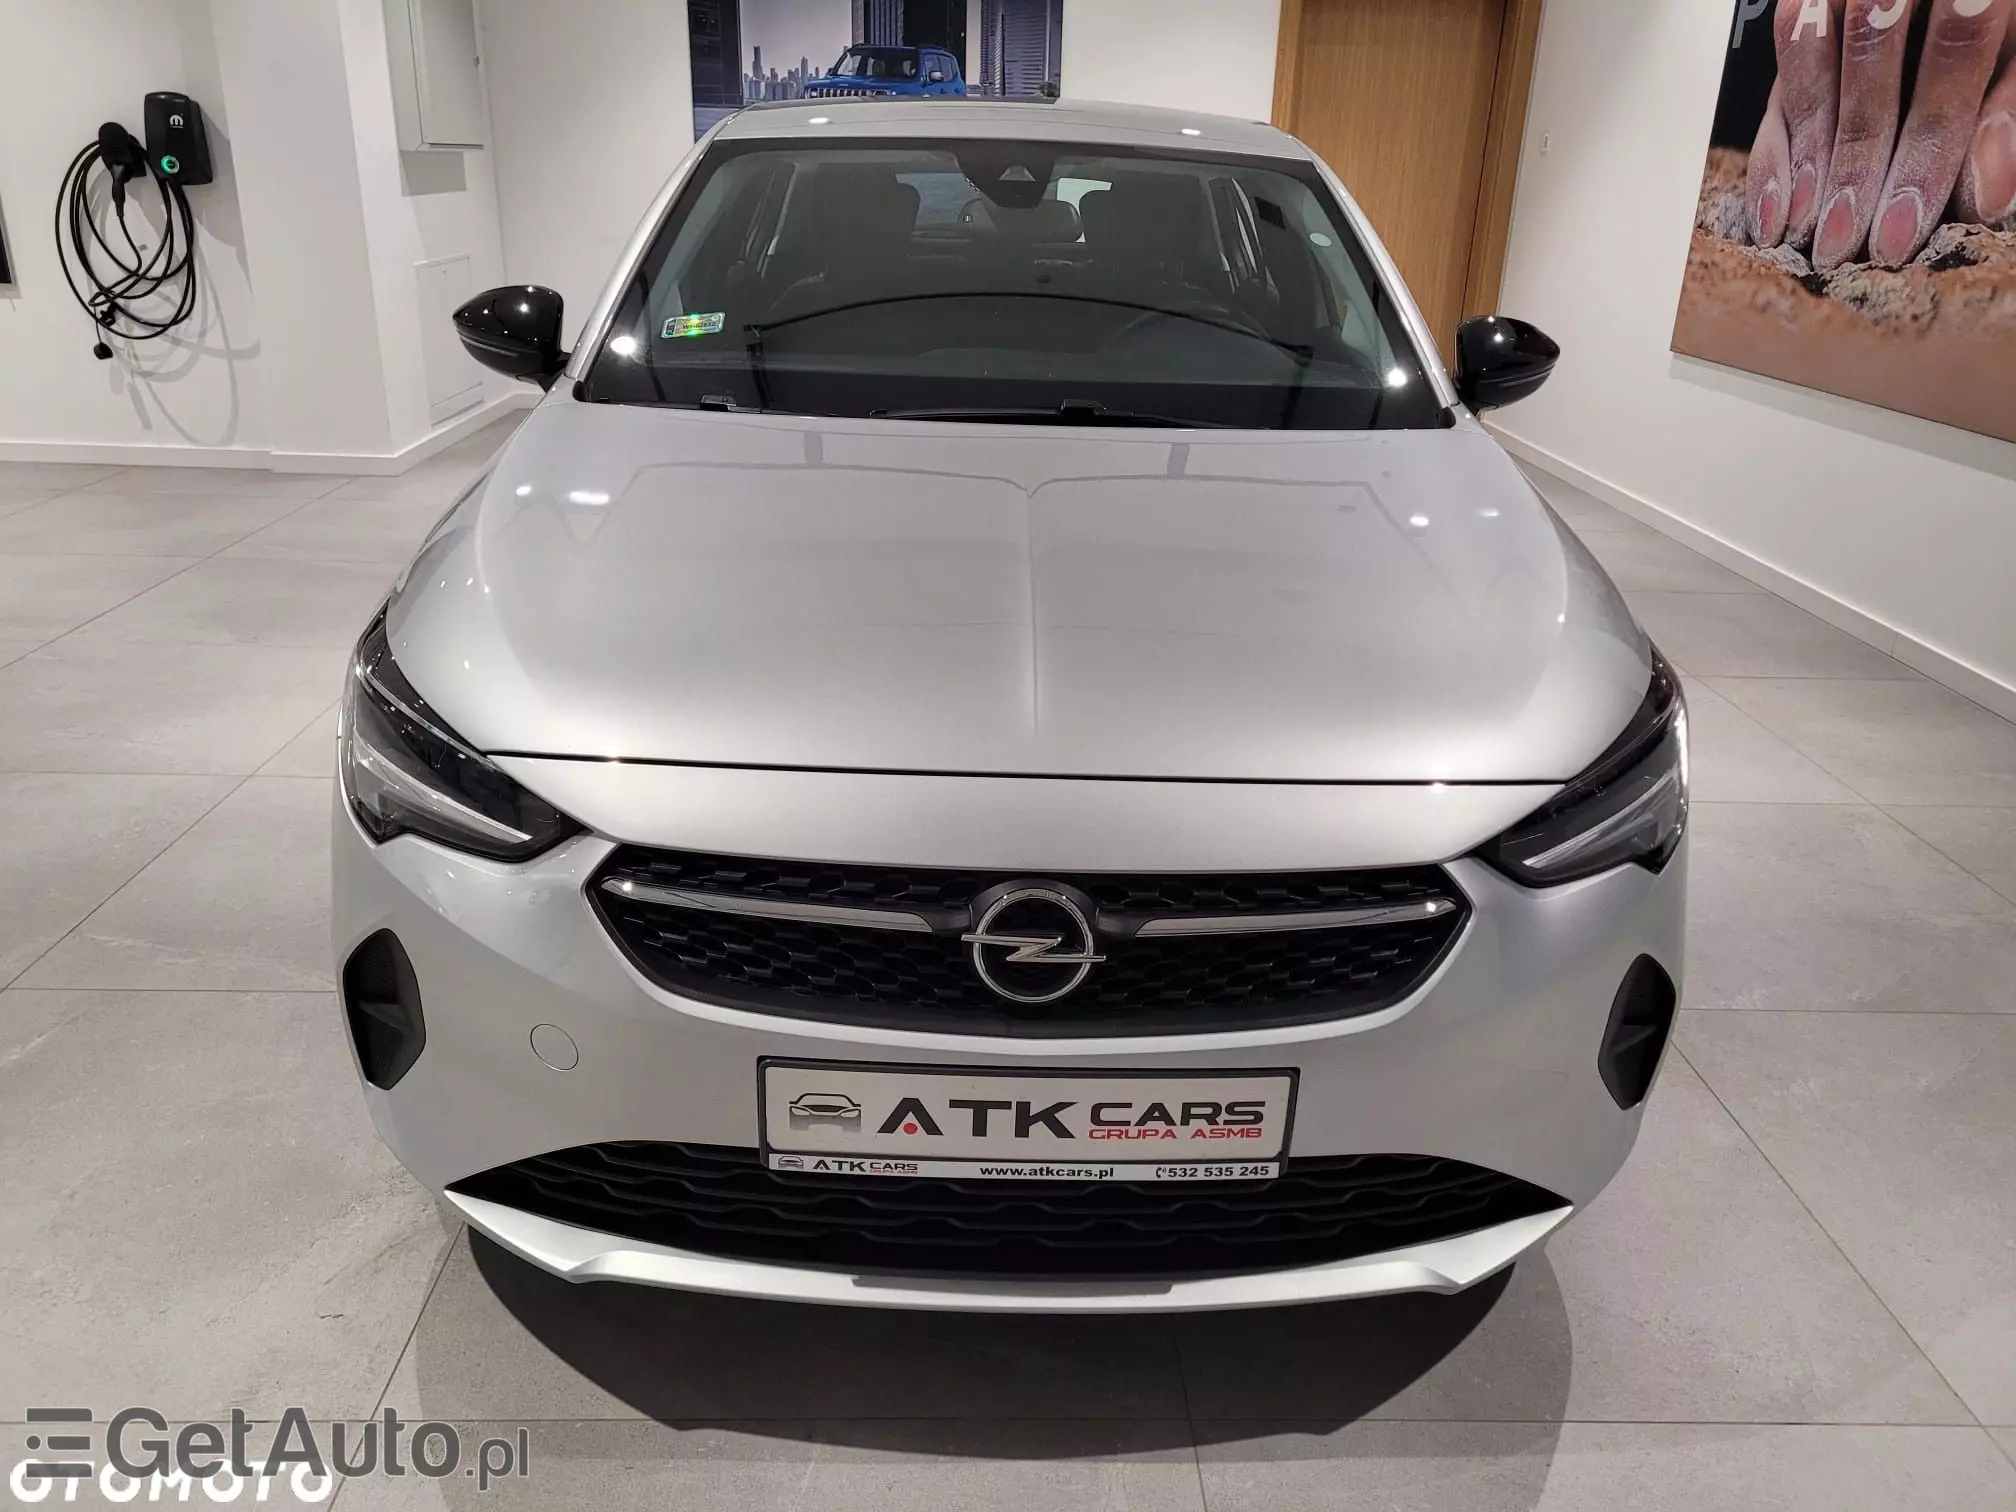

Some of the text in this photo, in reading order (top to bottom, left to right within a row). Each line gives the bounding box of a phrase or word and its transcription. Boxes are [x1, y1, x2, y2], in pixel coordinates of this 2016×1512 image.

[877, 1097, 1266, 1138] ATK CARS
[1088, 1127, 1262, 1139] GRUPA ASMB
[813, 1159, 867, 1172] ATK
[869, 1162, 918, 1170] CARS
[1167, 1166, 1269, 1178] 532 535 245
[980, 1166, 1114, 1179] www.atkcars.pl
